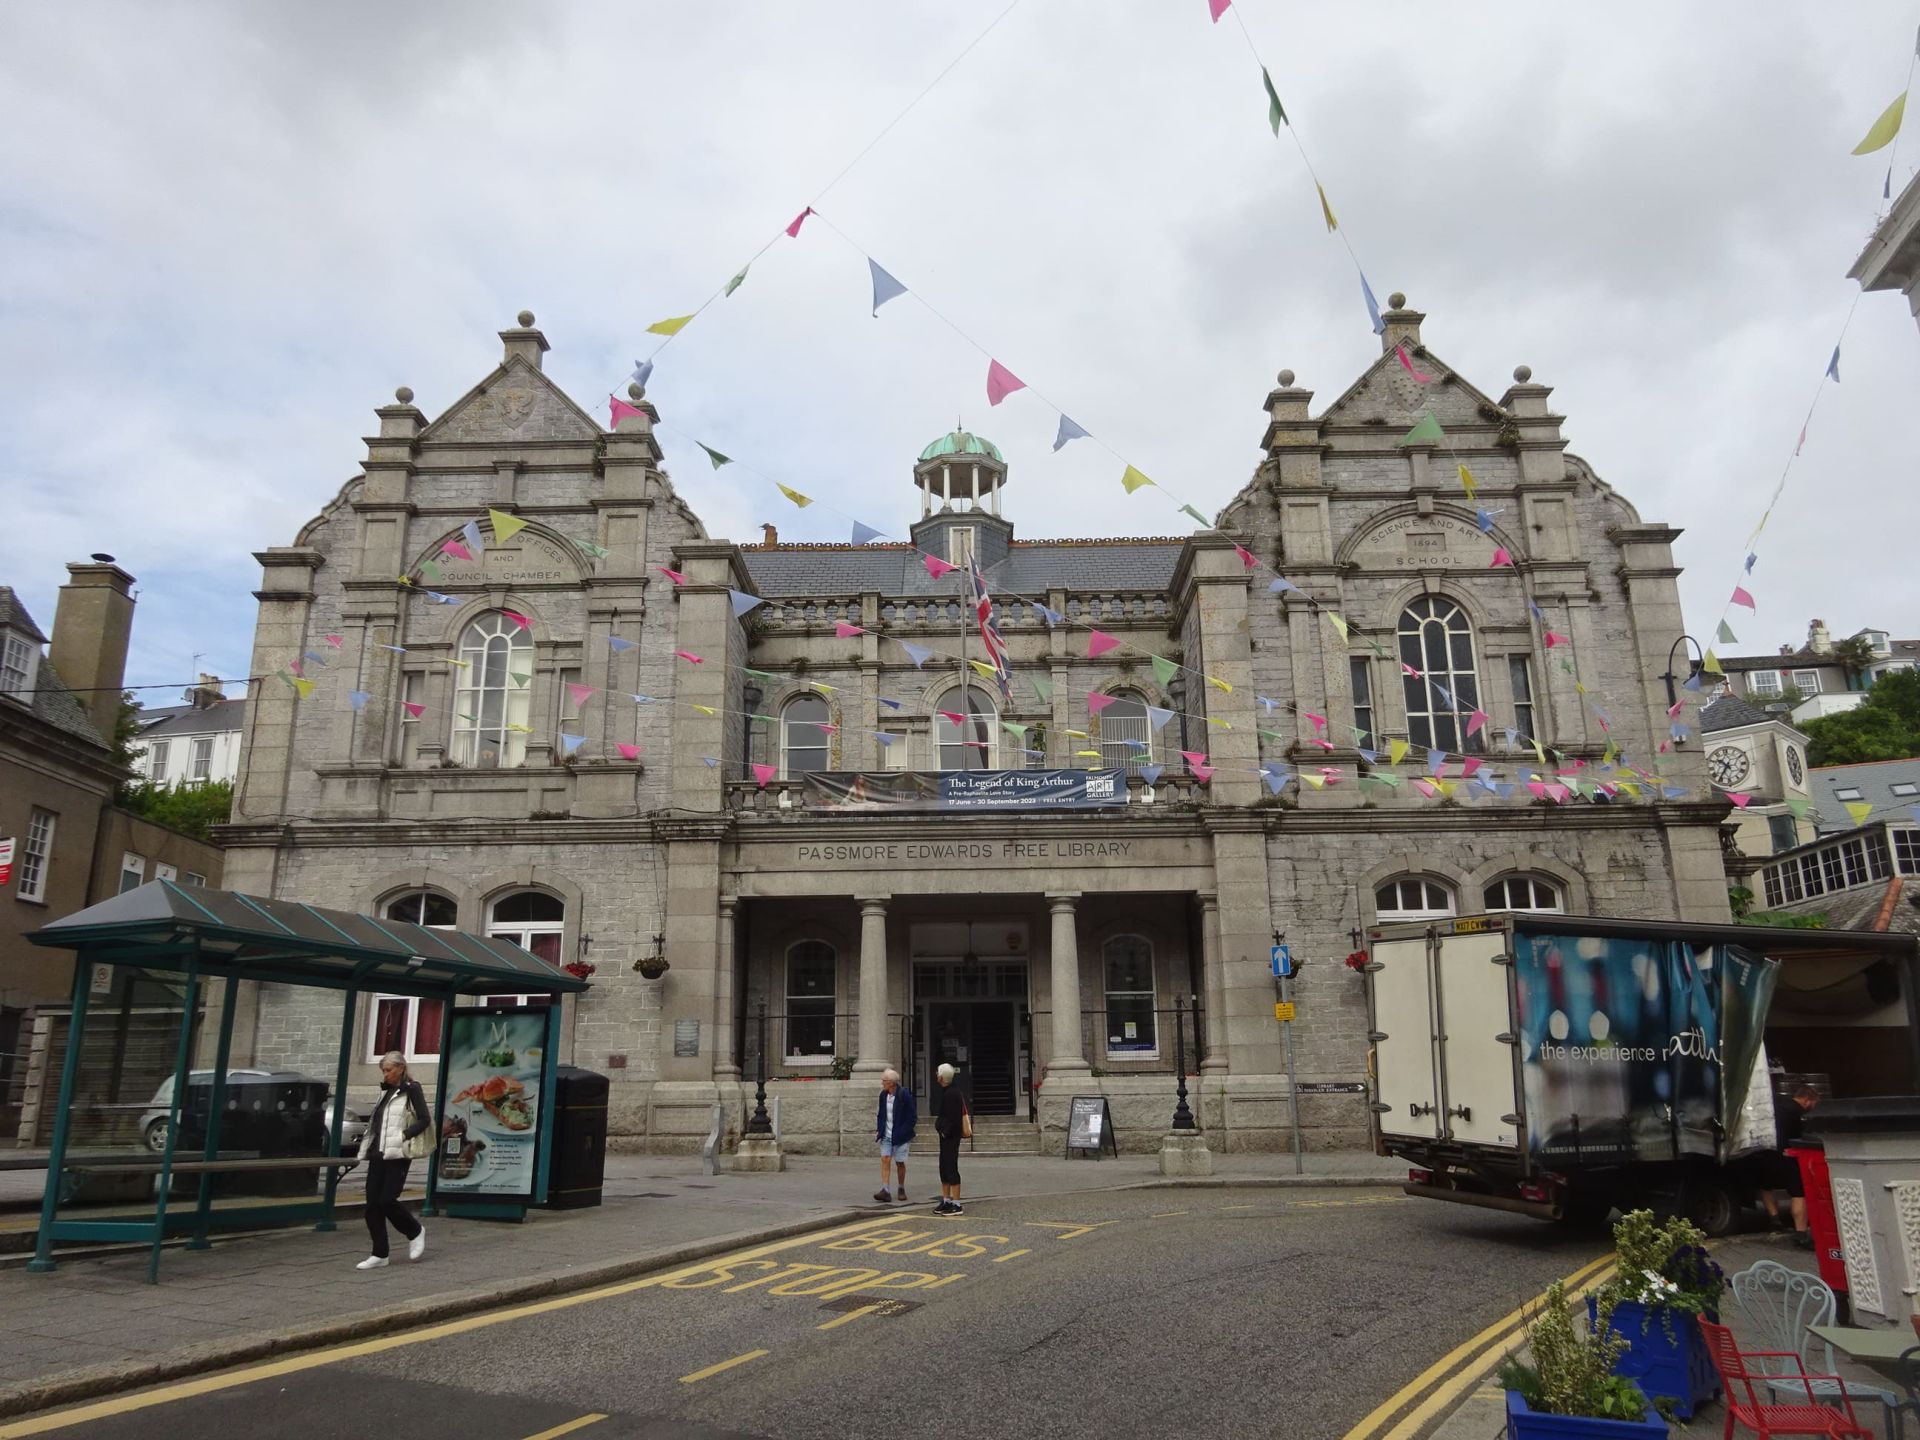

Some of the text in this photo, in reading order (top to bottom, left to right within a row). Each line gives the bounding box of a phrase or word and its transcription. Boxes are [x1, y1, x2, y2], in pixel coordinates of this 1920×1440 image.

[1370, 519, 1481, 544] SCIENCE AND ART
[517, 535, 565, 564] OFFICES
[1396, 557, 1463, 565] SCHOOL
[949, 777, 1074, 790] The Legend of King Arthur
[1086, 781, 1114, 792] ART
[798, 842, 1131, 861] PASSMORE EDWARDS FREE LIBRARY
[489, 1022, 508, 1043] M
[1540, 1041, 1566, 1061] the
[1571, 1042, 1655, 1065] experience
[819, 1229, 1010, 1259] BUS
[660, 1261, 939, 1299] STOP
